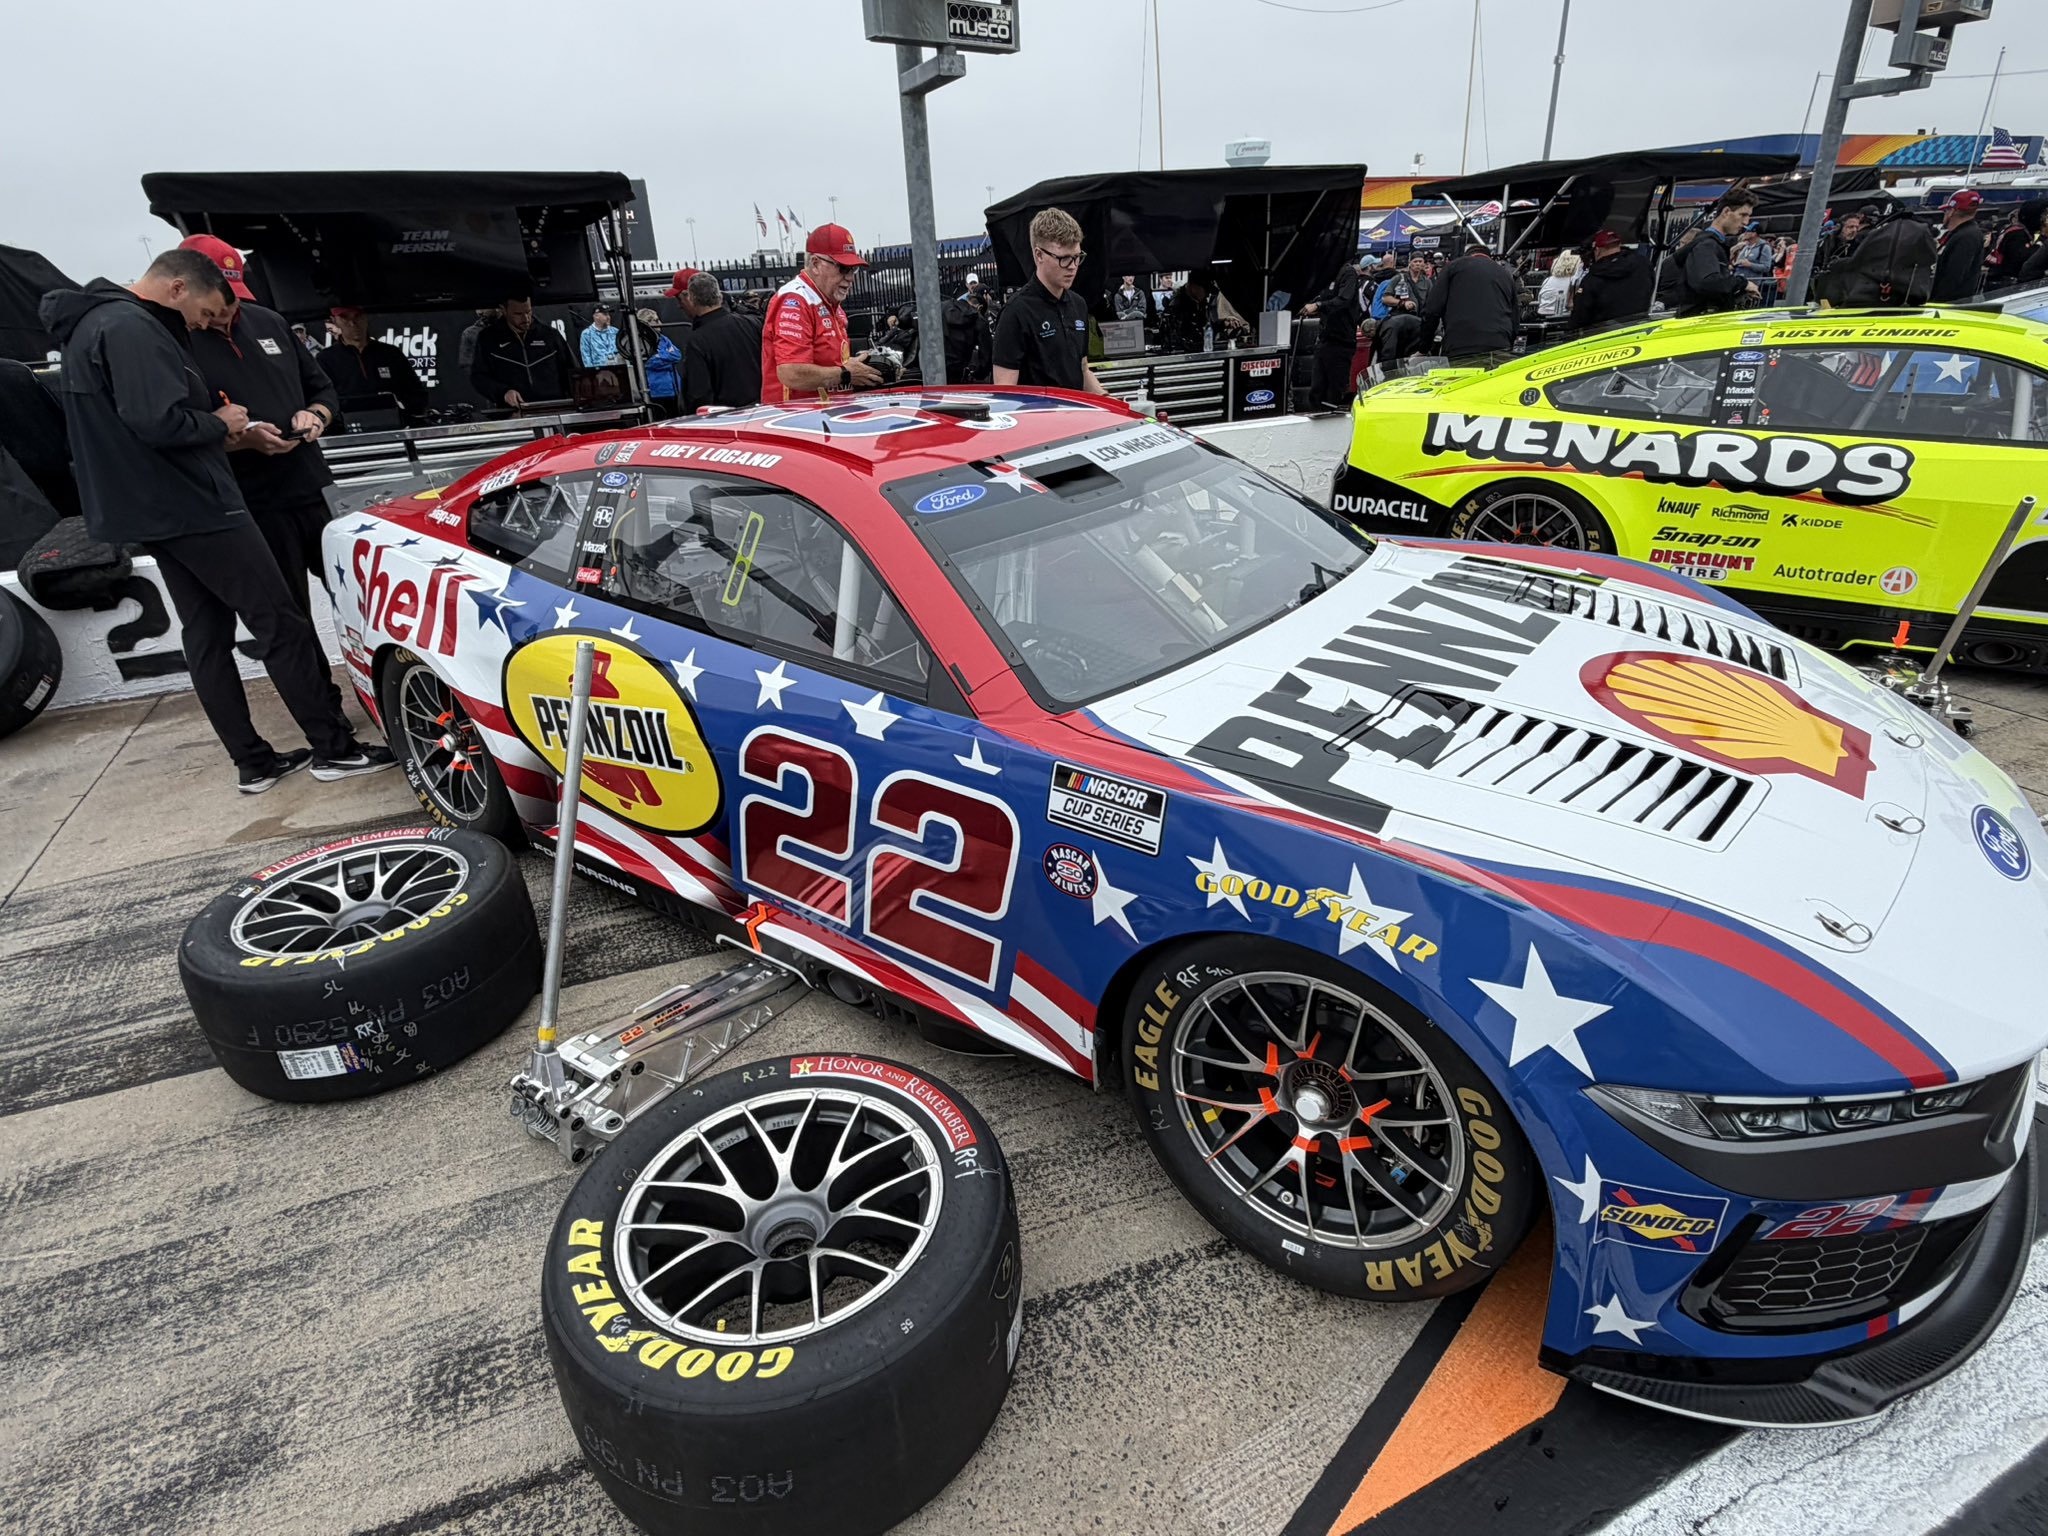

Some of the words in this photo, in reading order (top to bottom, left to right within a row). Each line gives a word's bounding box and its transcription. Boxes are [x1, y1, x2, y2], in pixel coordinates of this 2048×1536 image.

[391, 241, 457, 254] PENSKE
[402, 230, 449, 242] TEAM
[1771, 329, 1859, 339] AUSTIN
[1862, 328, 1960, 338] CINDRIC
[1242, 359, 1281, 370] DISCOUNT
[1536, 349, 1630, 378] FREIGHTLINER
[1734, 370, 1755, 381] PPG
[1726, 386, 1756, 395] Mazak
[650, 444, 702, 459] JOEY
[698, 448, 783, 469] LOGANO
[1089, 444, 1130, 462] LCPL
[1428, 411, 1910, 500] MENARDS
[1333, 494, 1429, 522] DURACELL
[1657, 497, 1701, 518] KNAUF
[1712, 506, 1770, 521] Richmond
[1801, 517, 1844, 529] KIDDE
[582, 540, 608, 554] Mazak
[1652, 526, 1761, 548] Snap-on
[1649, 548, 1756, 571] DISCOUNT
[1675, 566, 1721, 579] TIRE
[1773, 563, 1877, 586] Autotrader
[352, 538, 481, 657] Shell
[1085, 776, 1149, 810] NASCAR
[1062, 797, 1093, 818] CUP
[1092, 806, 1145, 835] SERIES
[273, 845, 328, 872] HONOR
[350, 827, 425, 845] REMEMBER
[739, 725, 1020, 992] 22
[1051, 847, 1091, 871] NASCAR
[576, 862, 638, 897] RACING
[1049, 871, 1091, 895] SALUTES
[1057, 864, 1083, 879] 250
[1176, 964, 1201, 989] RF
[619, 1026, 644, 1044] 22
[1134, 979, 1181, 1091] EAGLE
[817, 1056, 884, 1078] HONOR
[886, 1071, 907, 1083] AND
[903, 1076, 970, 1146] REMEMBER
[1601, 1204, 1715, 1236] SUNOCO
[1762, 1194, 1898, 1241] 22
[710, 1469, 794, 1504] A03
